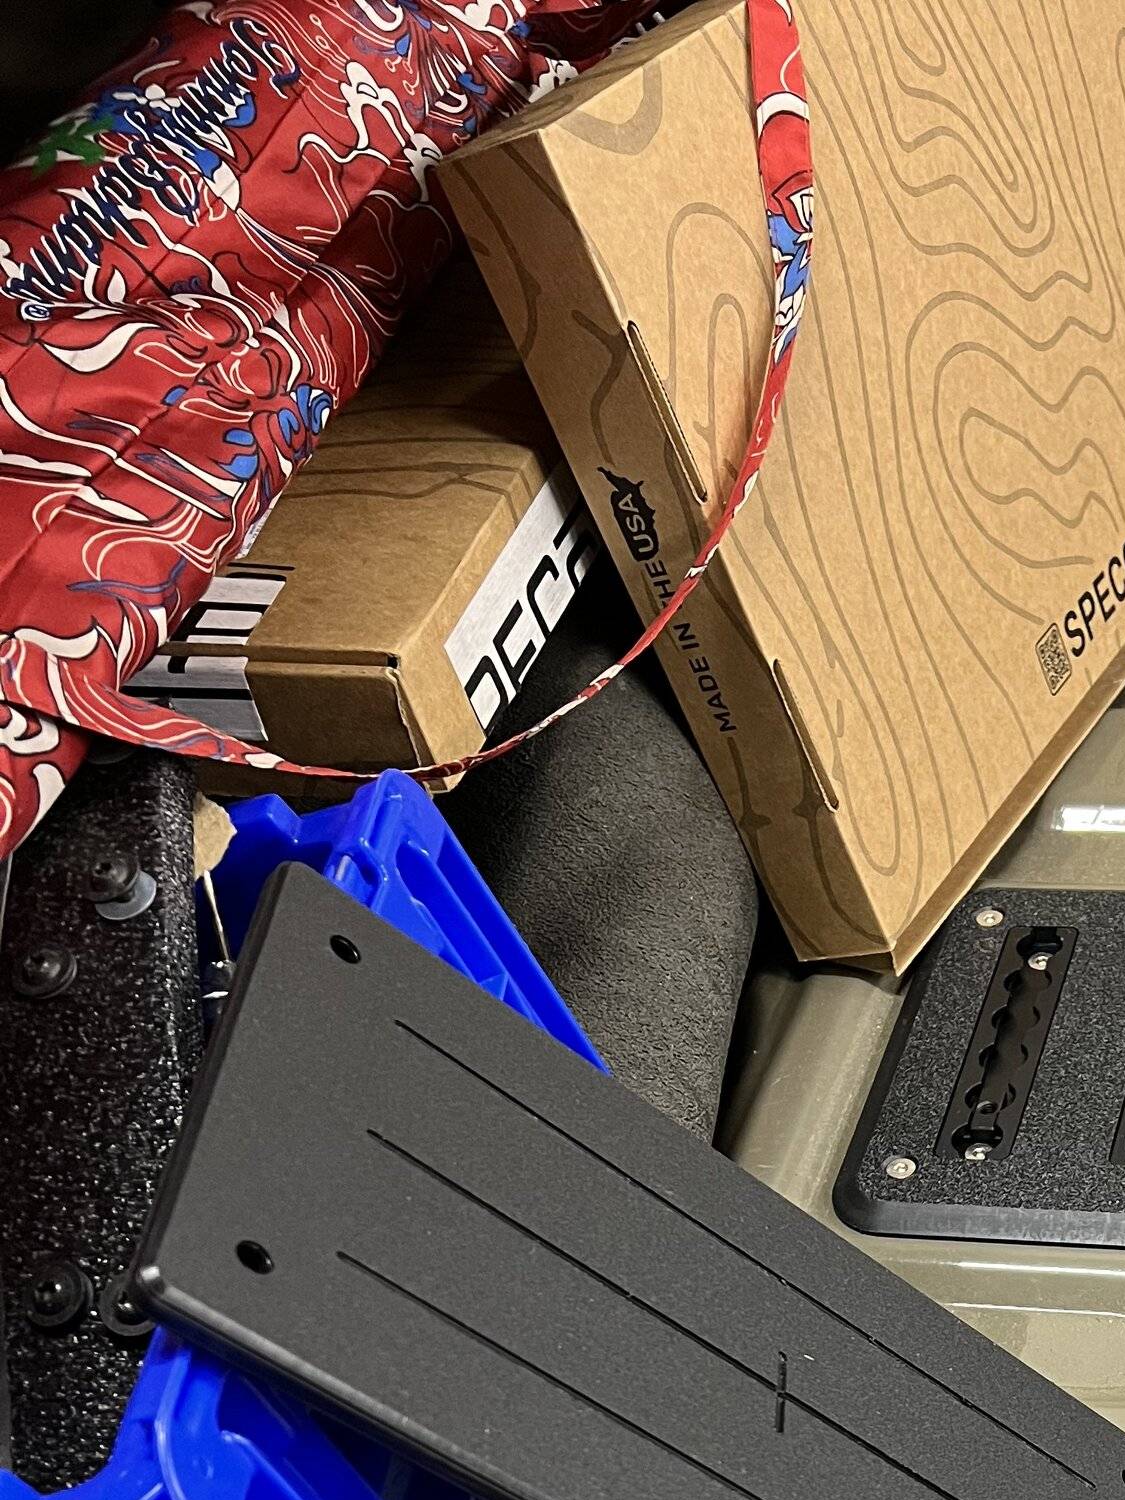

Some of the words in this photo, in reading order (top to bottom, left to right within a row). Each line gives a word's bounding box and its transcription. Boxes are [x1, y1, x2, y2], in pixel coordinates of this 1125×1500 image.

[123, 17, 302, 157] Tommy
[618, 491, 656, 555] USA
[674, 621, 700, 650] IN
[689, 655, 737, 733] MADE
